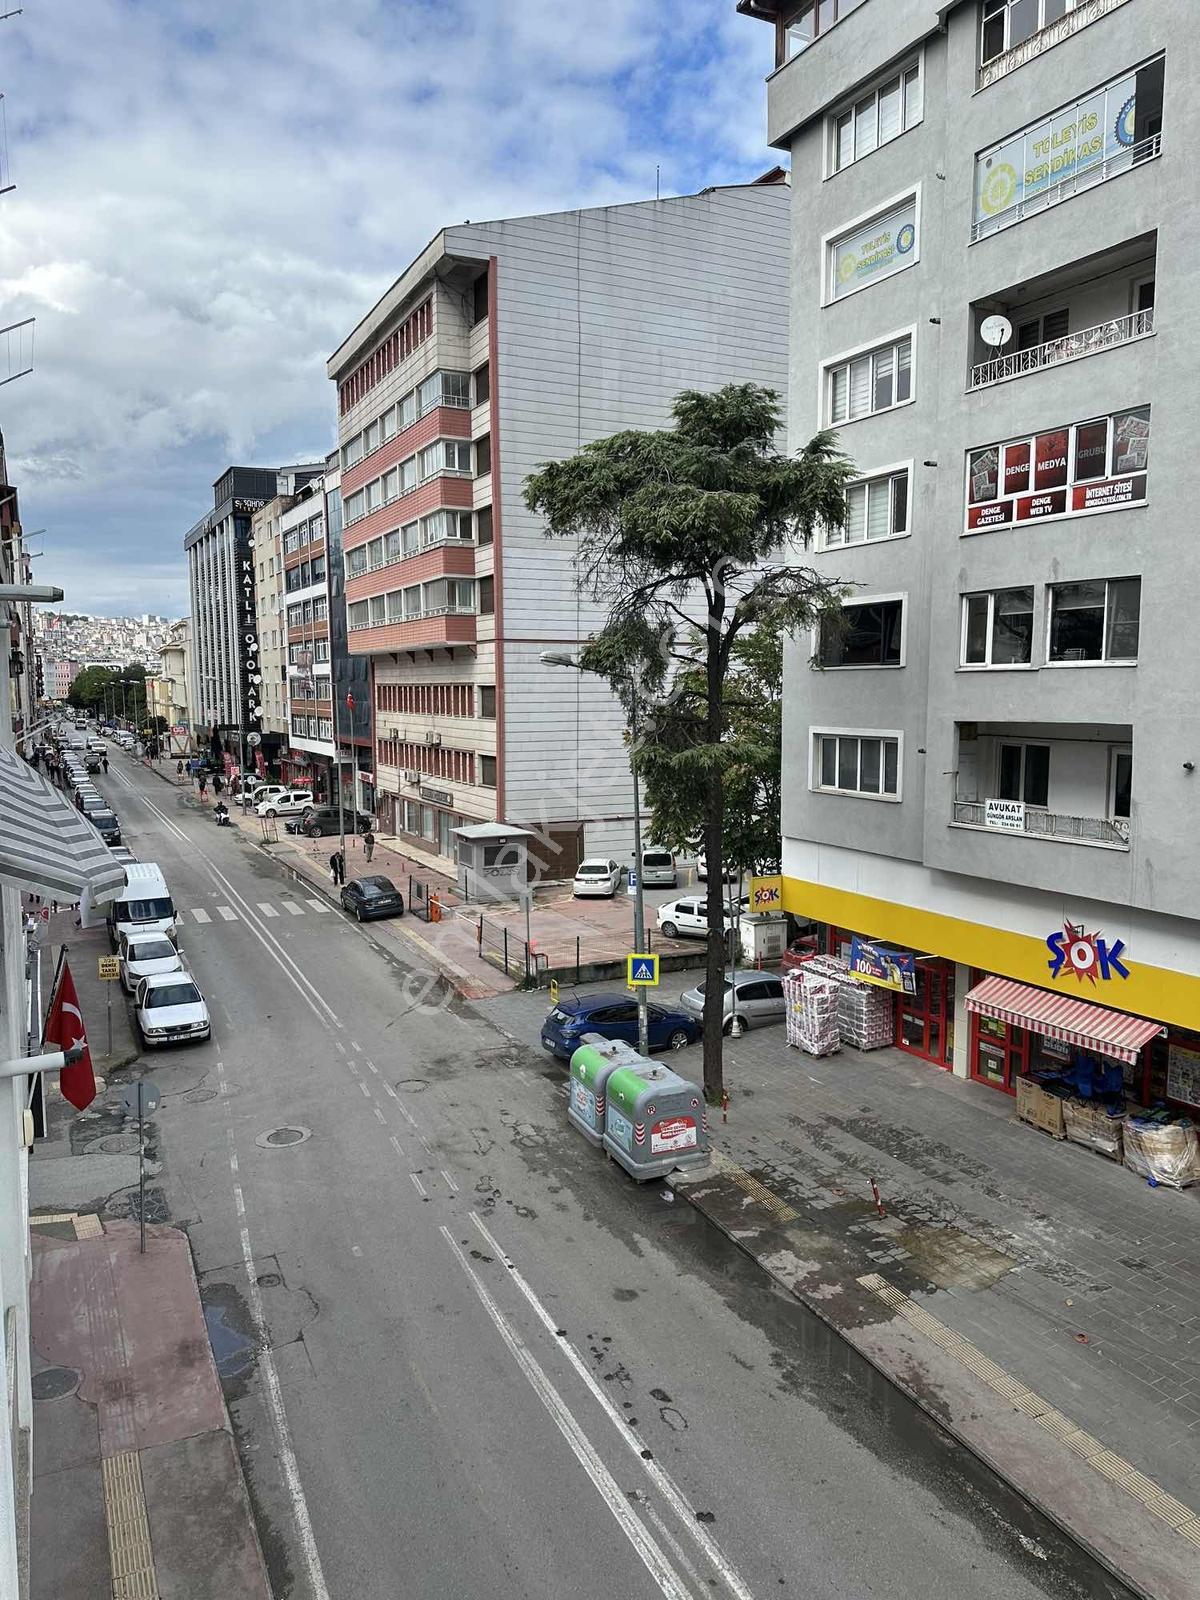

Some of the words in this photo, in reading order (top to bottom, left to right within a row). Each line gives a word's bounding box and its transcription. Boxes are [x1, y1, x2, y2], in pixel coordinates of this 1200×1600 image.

[1006, 463, 1030, 476] DENGE
[1037, 457, 1067, 472] MEDYA
[1078, 446, 1106, 459] GRUBU
[1030, 506, 1044, 515] WEB
[1044, 505, 1053, 513] TV
[1031, 496, 1052, 507] DENGE
[977, 513, 1005, 525] GAZETESİ
[981, 506, 1001, 516] DENGE
[243, 560, 253, 625] KATLI
[244, 633, 257, 722] OTOPARK
[989, 803, 1022, 814] AVUKAT
[755, 888, 780, 906] ŞOK
[1046, 931, 1131, 981] ŞOK
[856, 958, 872, 975] 100
